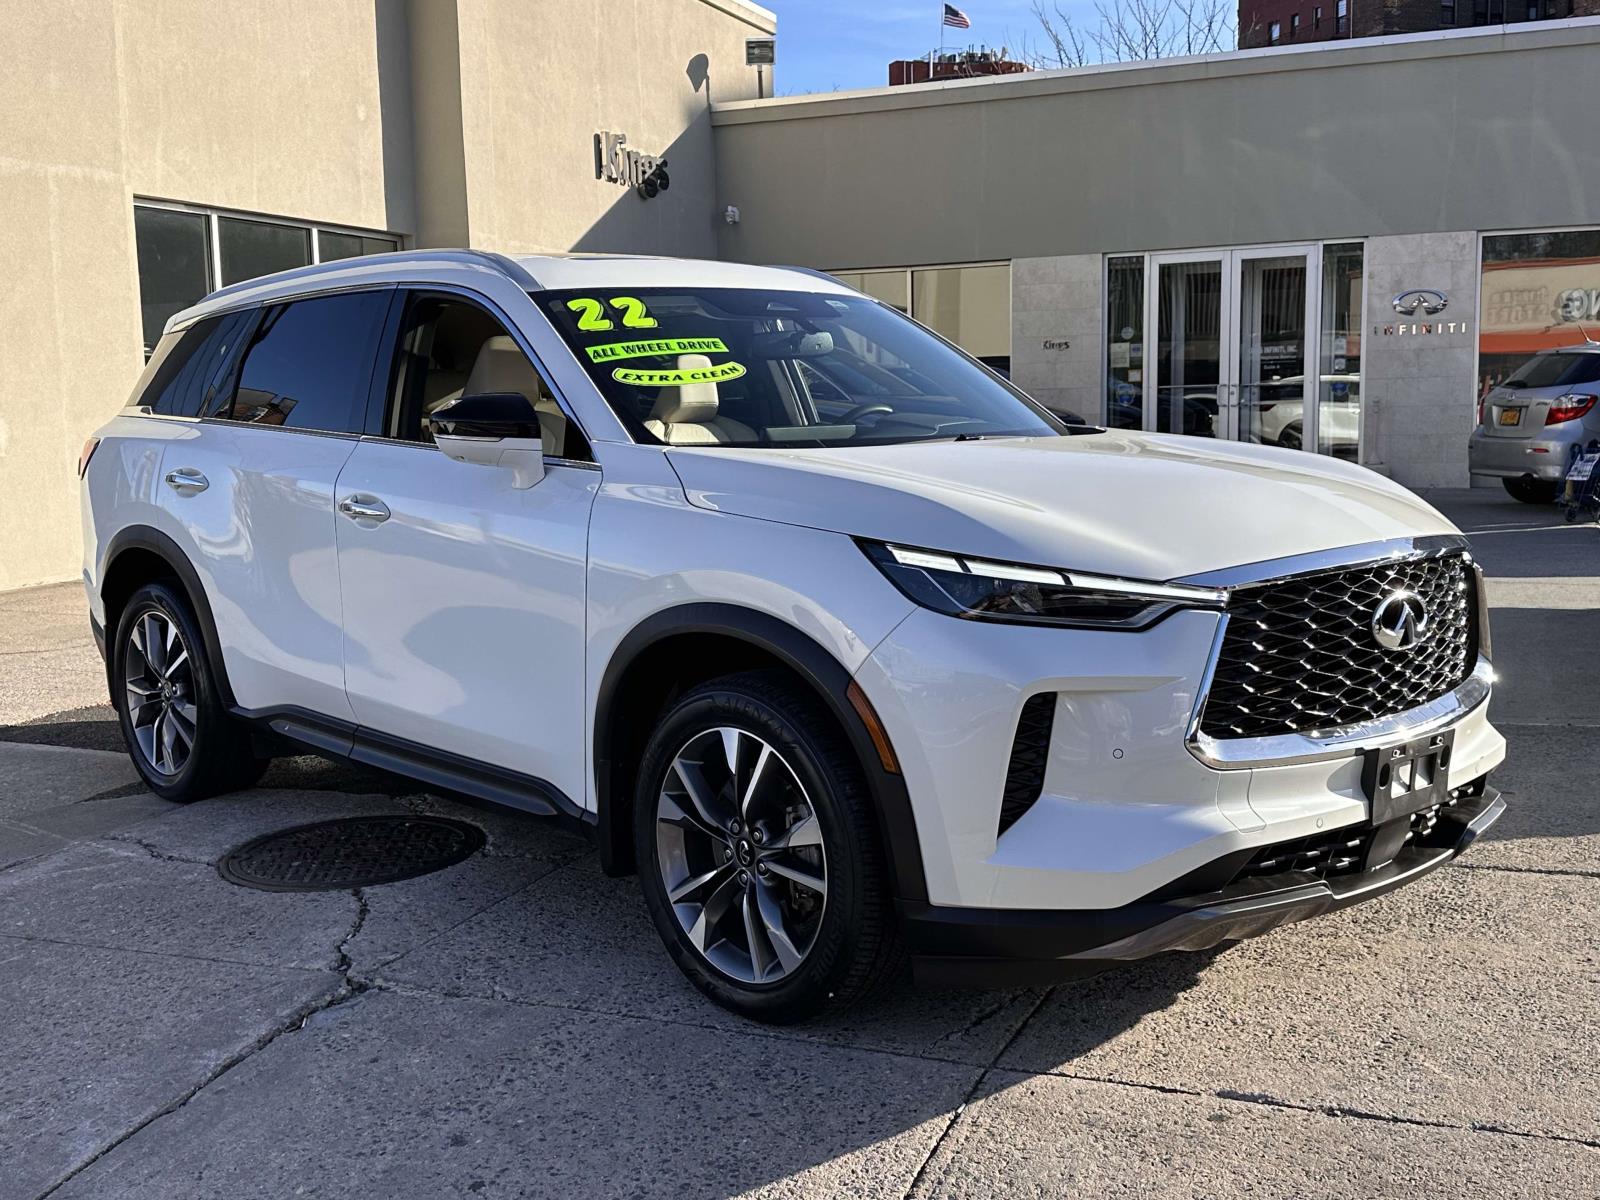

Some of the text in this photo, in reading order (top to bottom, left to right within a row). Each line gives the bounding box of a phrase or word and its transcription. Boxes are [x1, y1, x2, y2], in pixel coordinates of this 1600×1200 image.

[567, 297, 658, 331] 22
[1373, 322, 1467, 336] INFINITI
[591, 340, 721, 360] ALL WHEEL DRIVE
[620, 365, 740, 383] EXTRA CLEAN
